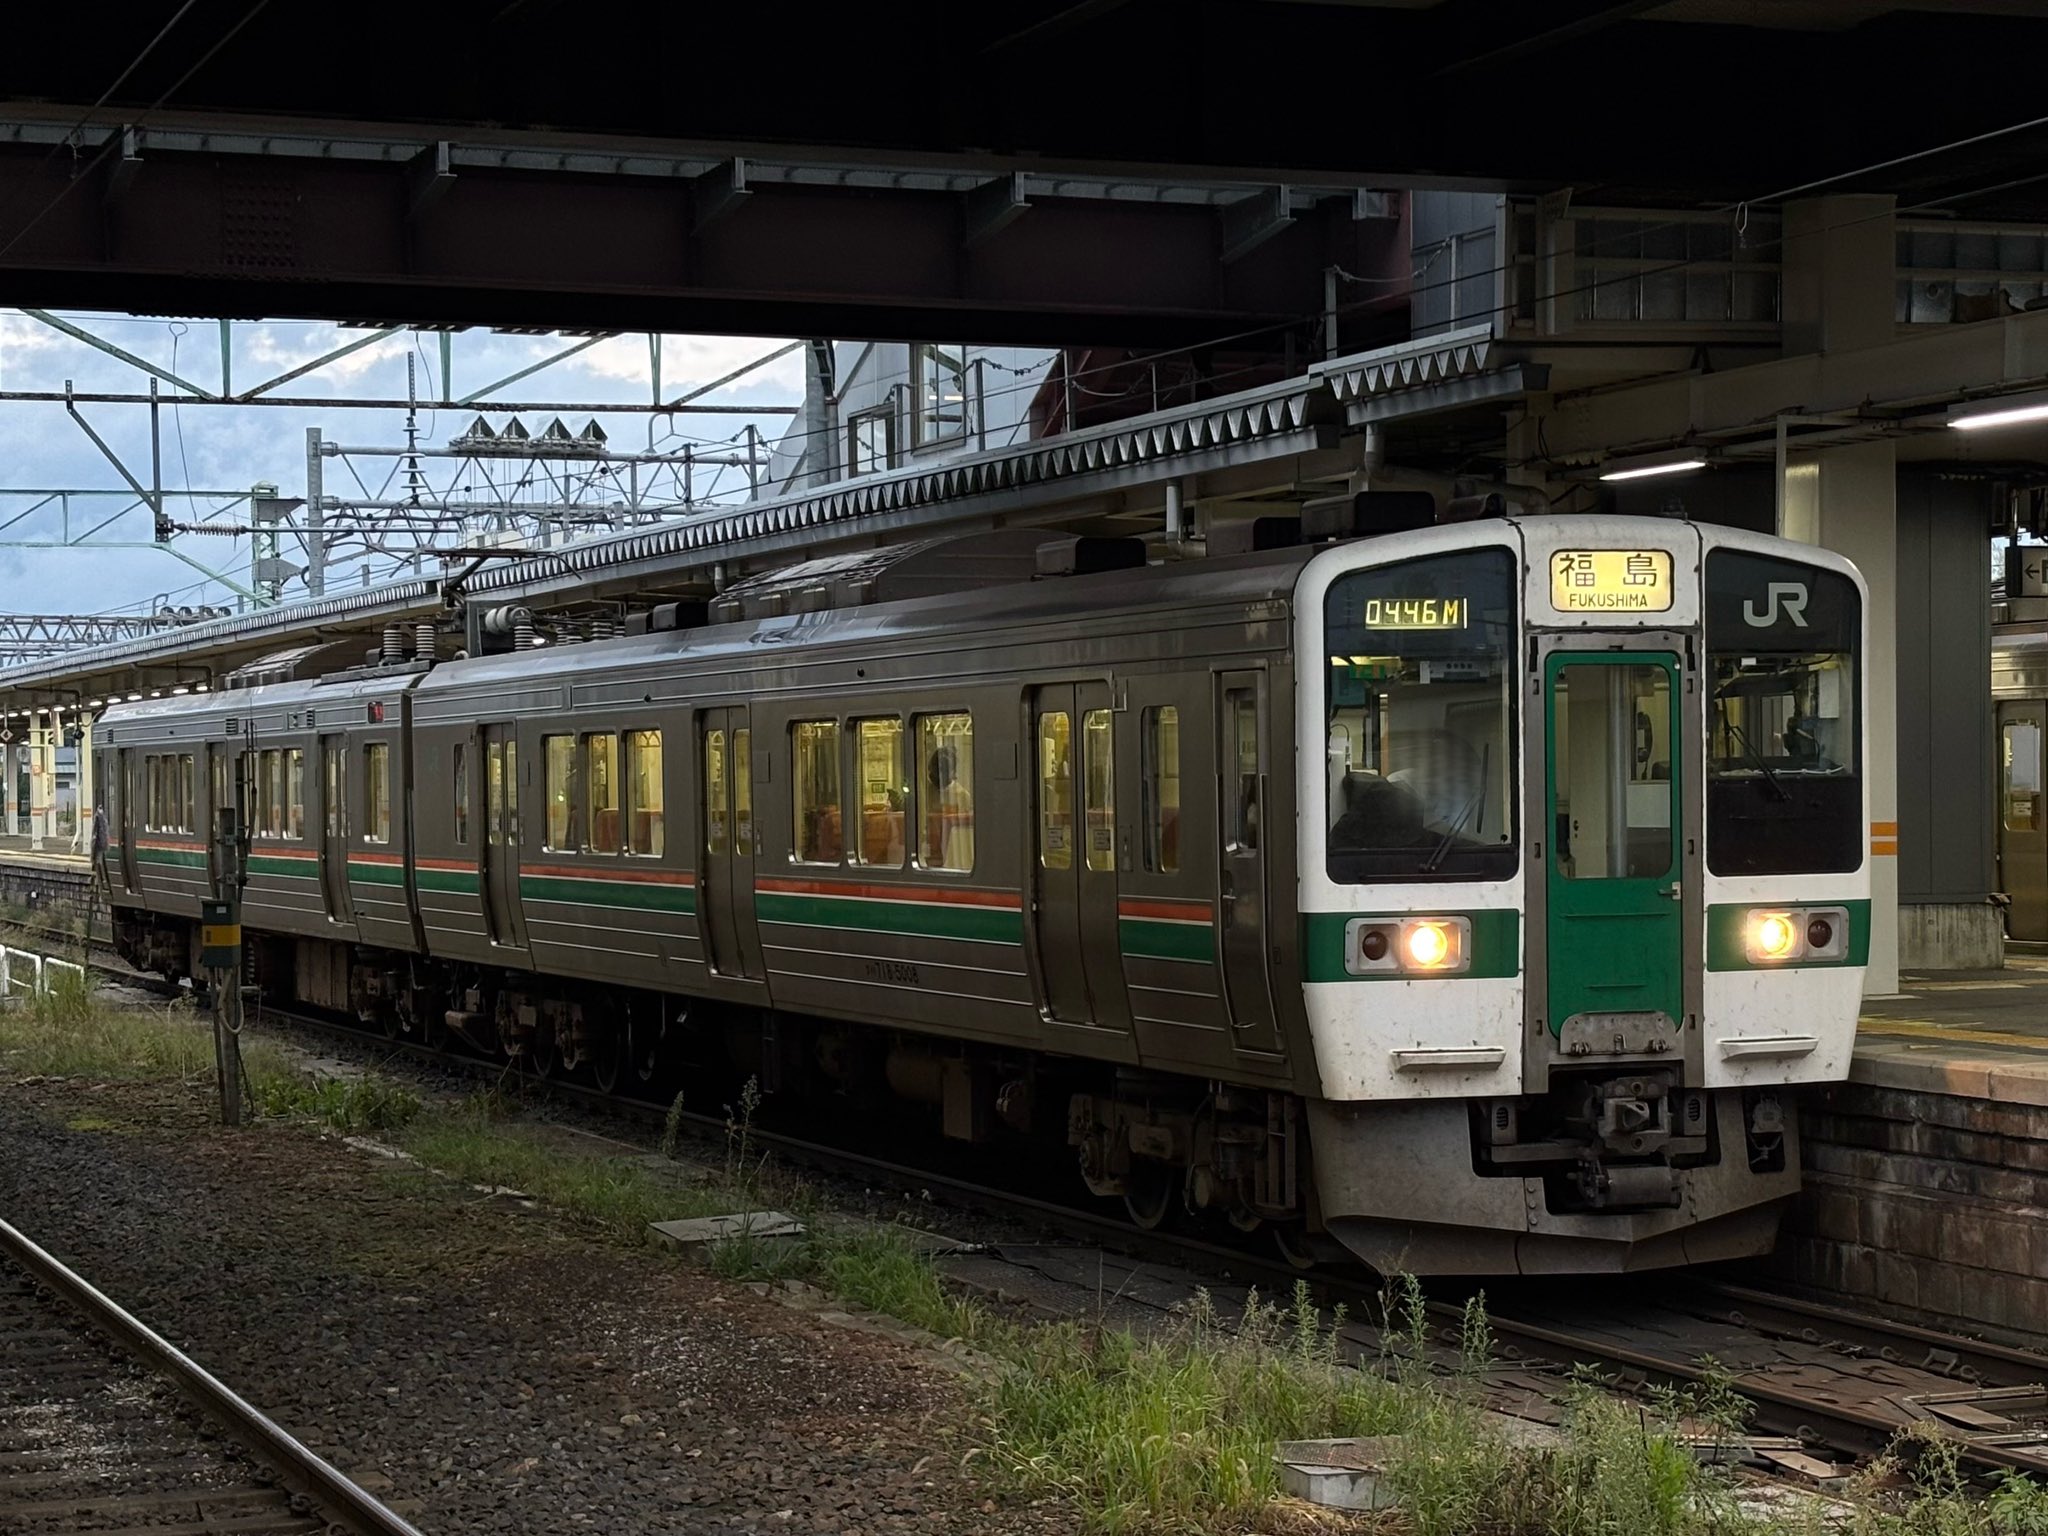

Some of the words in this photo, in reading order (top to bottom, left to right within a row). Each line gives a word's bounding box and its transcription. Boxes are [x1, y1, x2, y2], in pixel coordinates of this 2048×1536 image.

[1559, 553, 1657, 587] 福島
[1365, 600, 1459, 625] 0446M
[1569, 594, 1648, 607] FUKUSHIMA
[1743, 582, 1808, 627] JR
